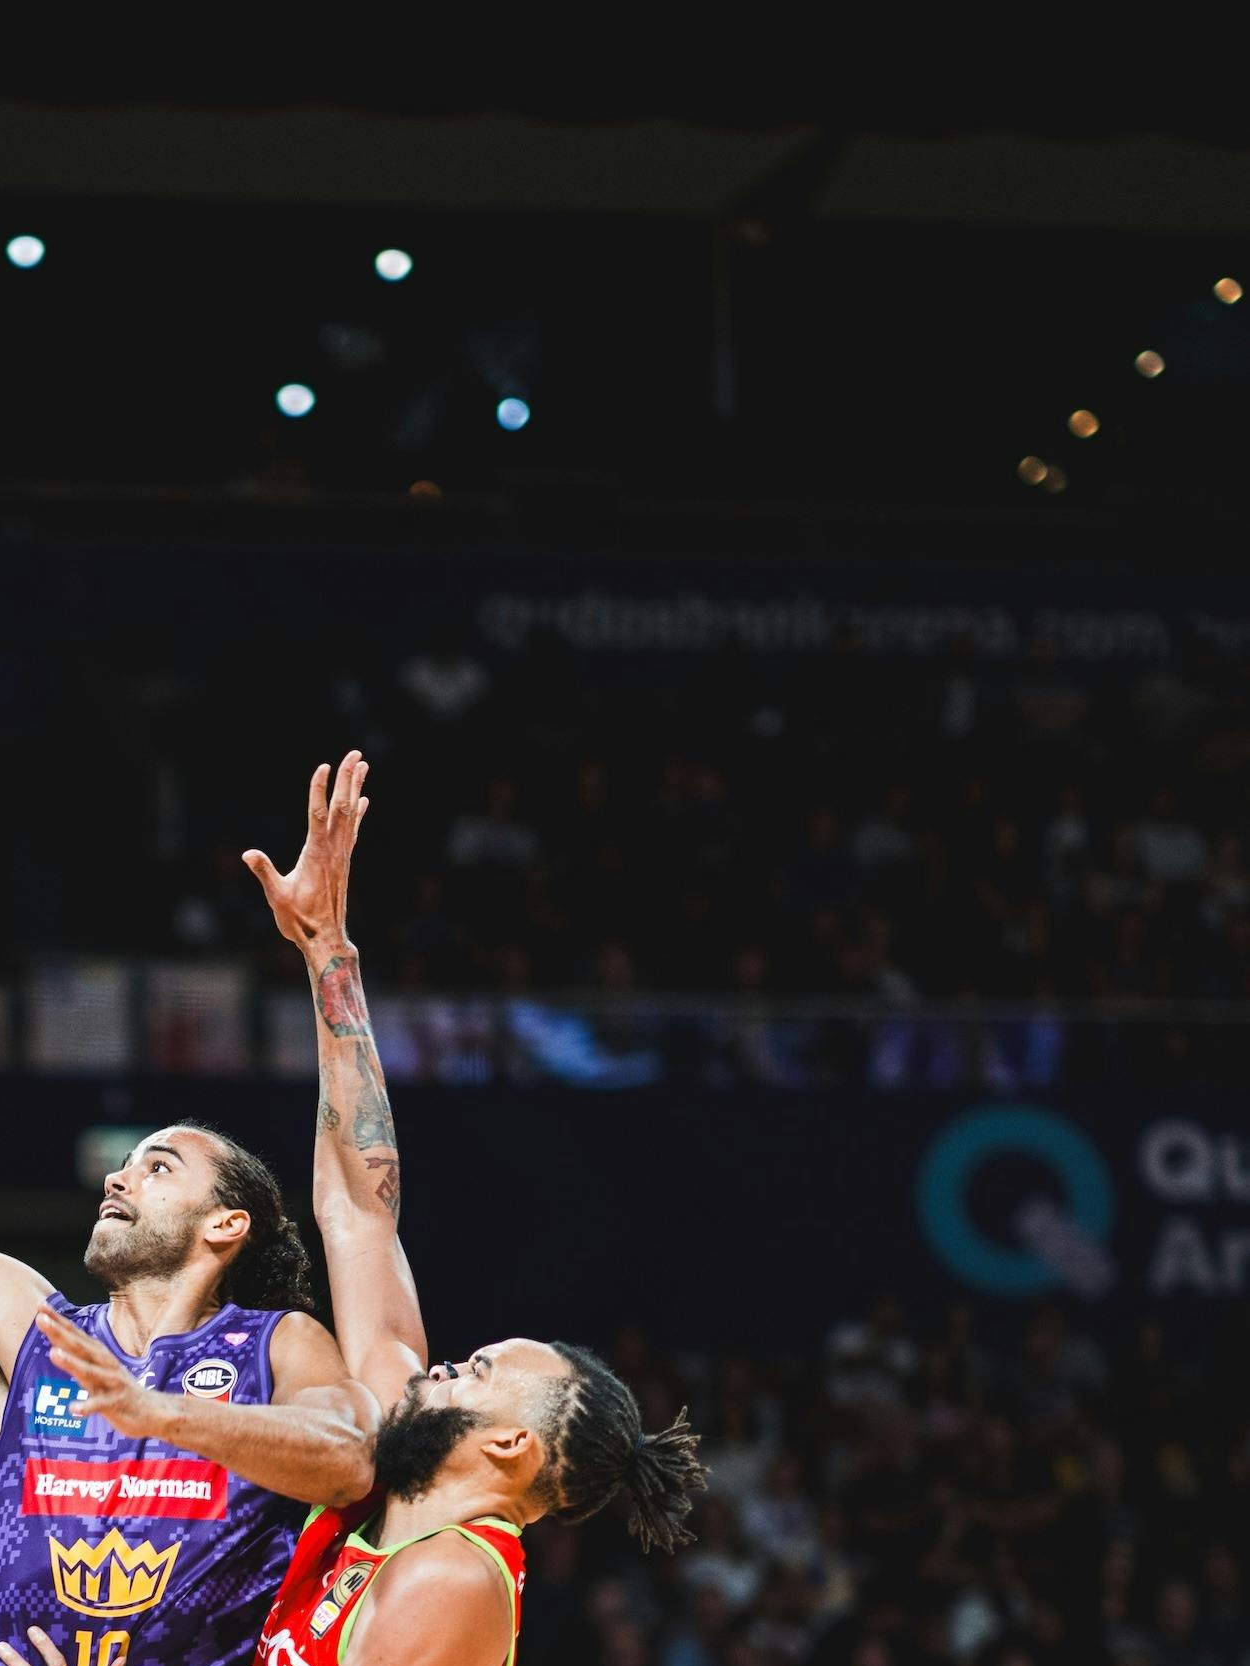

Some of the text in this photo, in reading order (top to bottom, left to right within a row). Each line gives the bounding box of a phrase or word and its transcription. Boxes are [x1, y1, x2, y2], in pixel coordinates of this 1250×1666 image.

[194, 1369, 225, 1387] NBL
[34, 1415, 82, 1429] HOSTPLUS
[35, 1473, 212, 1502] Harvey Norman
